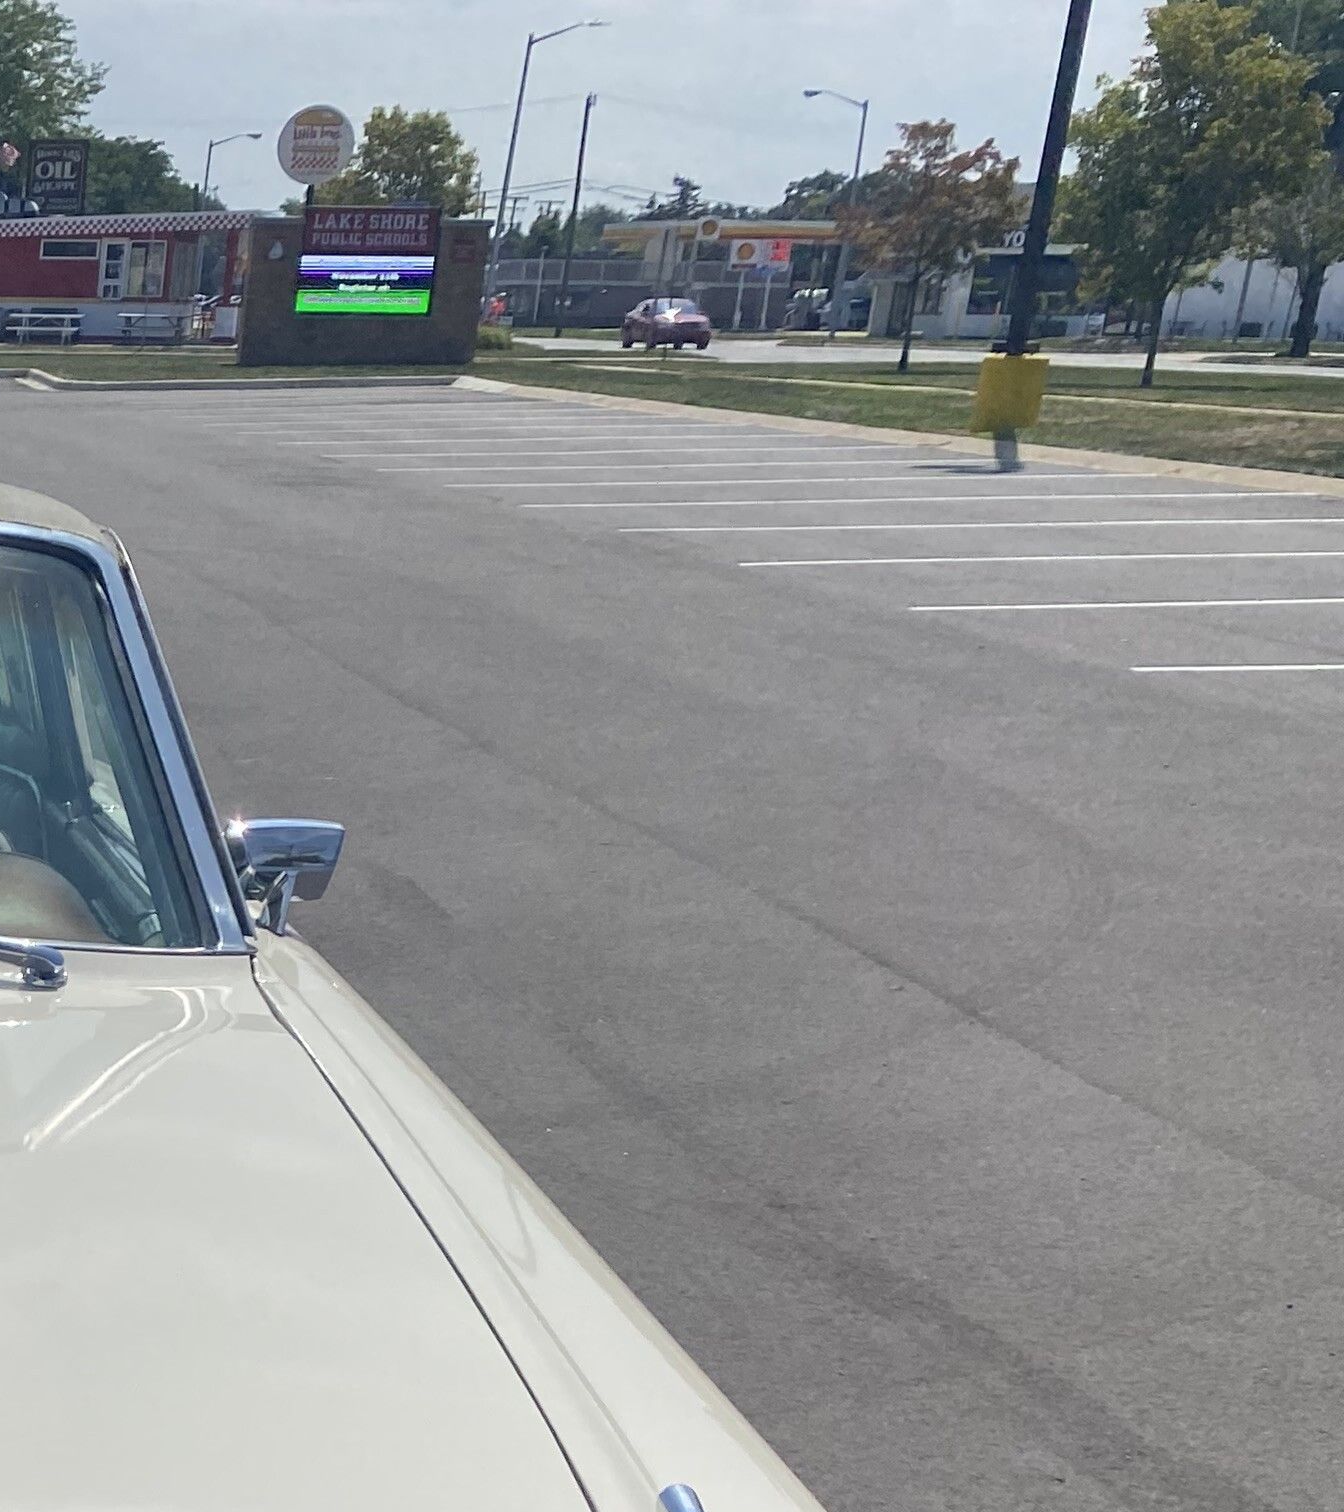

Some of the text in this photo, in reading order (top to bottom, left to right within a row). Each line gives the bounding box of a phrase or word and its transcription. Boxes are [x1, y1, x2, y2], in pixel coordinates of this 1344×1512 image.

[35, 161, 77, 179] OIL
[313, 213, 430, 231] LAKE SHORE
[311, 232, 428, 246] PUBLIC SCHOOLS
